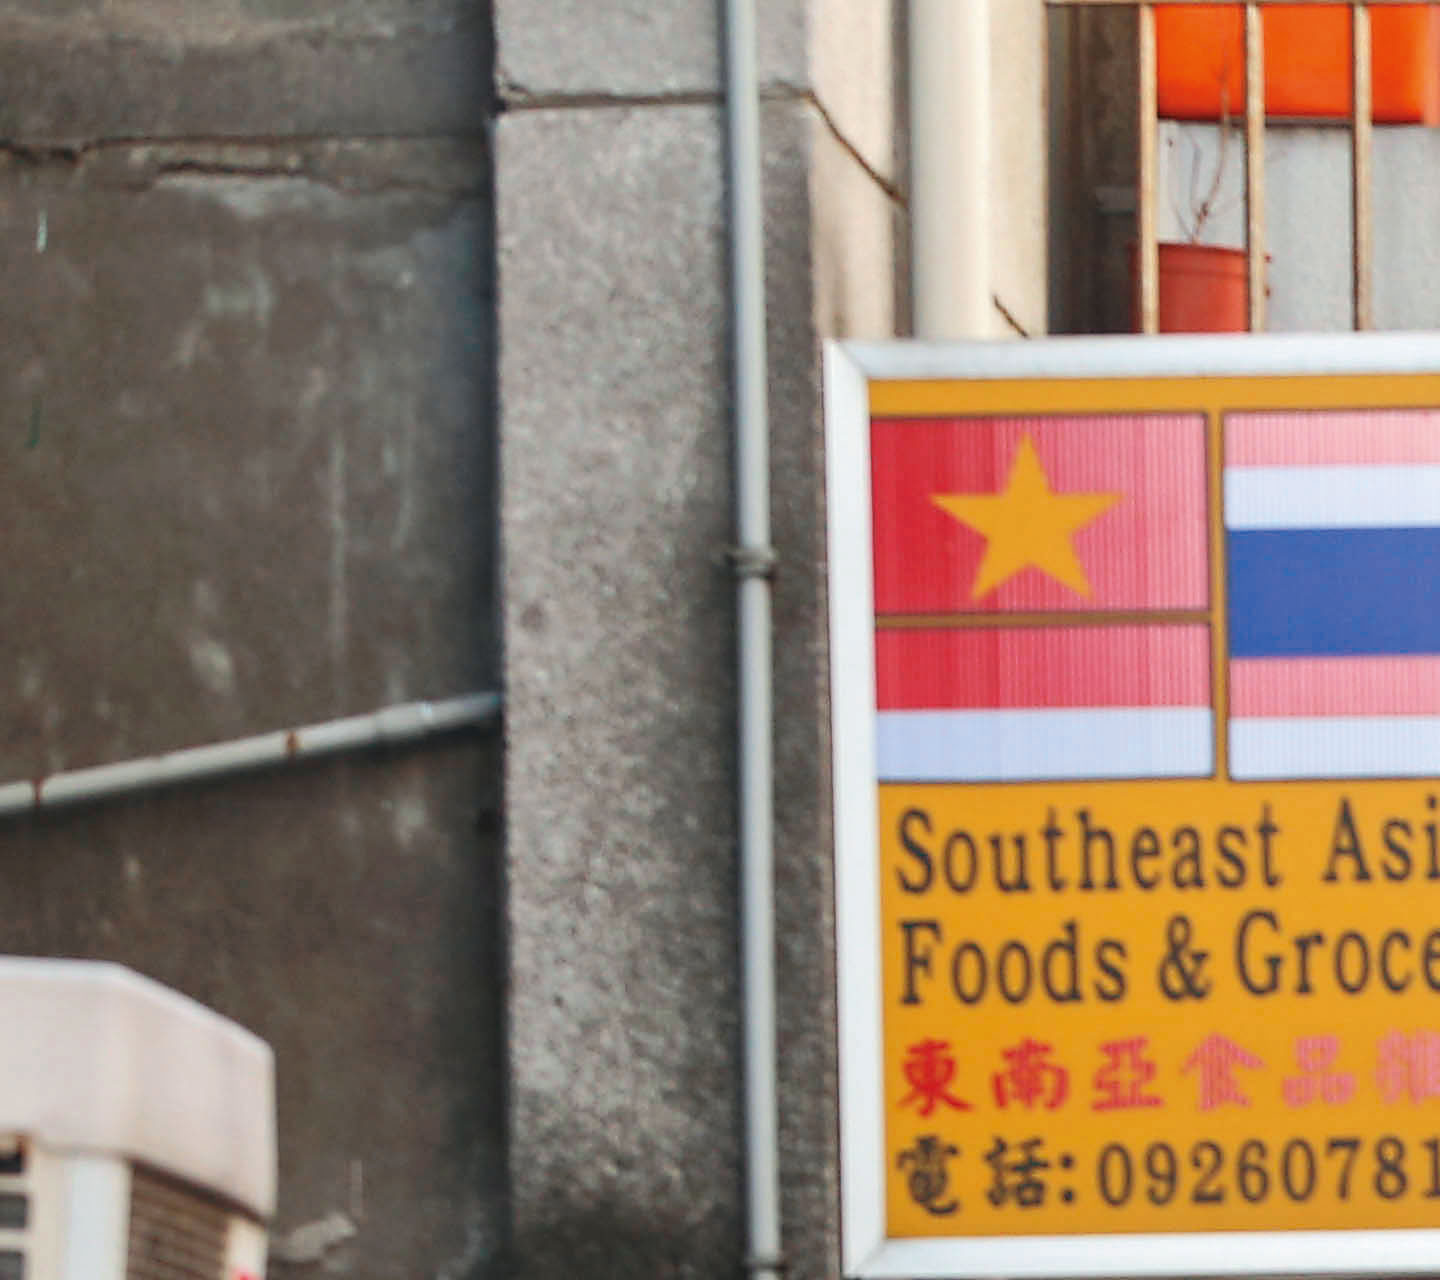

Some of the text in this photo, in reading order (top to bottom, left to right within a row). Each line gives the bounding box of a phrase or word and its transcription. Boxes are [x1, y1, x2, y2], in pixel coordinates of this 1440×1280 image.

[894, 804, 1281, 899] Southeast
[896, 918, 1129, 1008] Foods
[1158, 914, 1213, 1003] &
